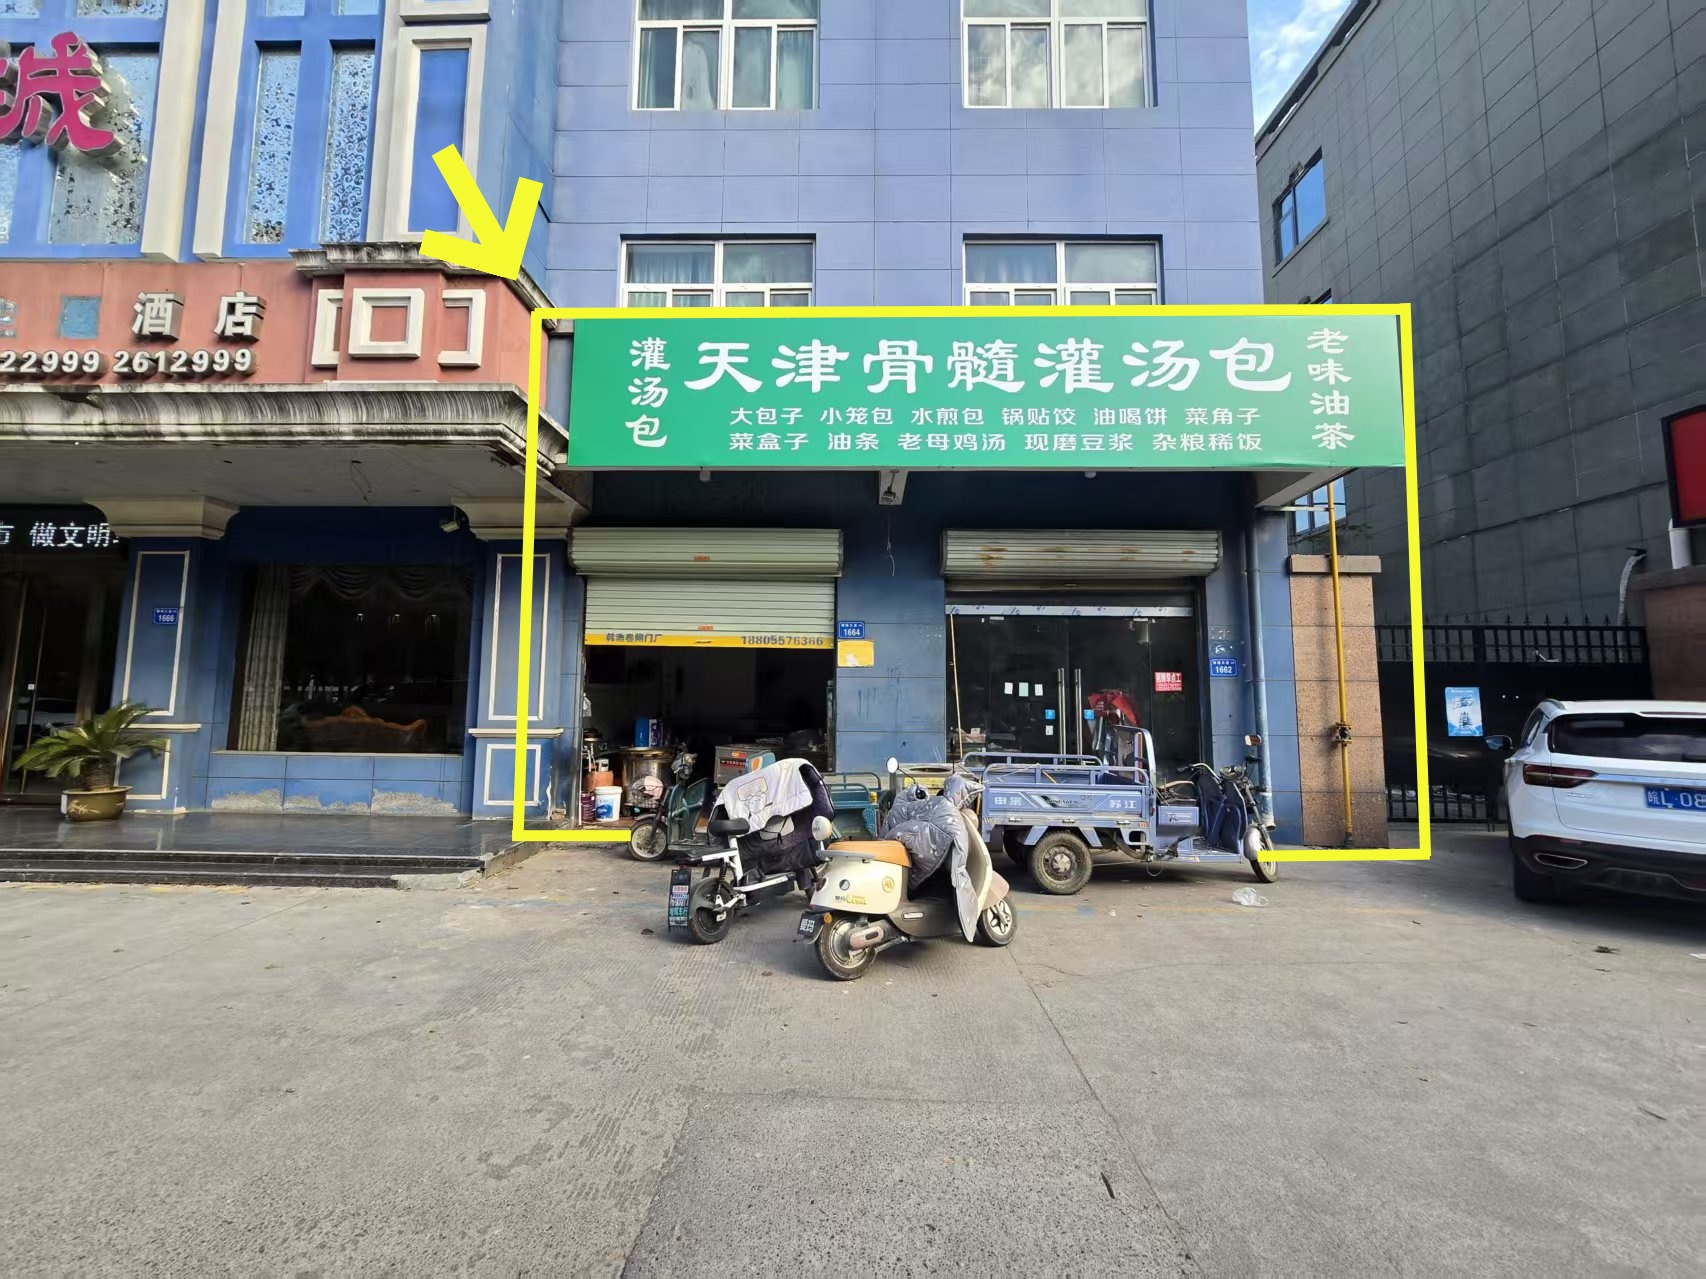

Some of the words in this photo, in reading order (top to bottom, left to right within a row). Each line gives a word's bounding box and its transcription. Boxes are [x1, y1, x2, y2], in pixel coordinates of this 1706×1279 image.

[132, 290, 260, 337] 酒店
[112, 348, 253, 373] 2612999
[683, 337, 1291, 394] 天津骨髓灌汤包
[625, 336, 671, 448] 灌汤包
[1305, 328, 1356, 450] 老味油茶
[731, 406, 803, 425] 大包子
[820, 406, 893, 425] 小笼包
[911, 406, 984, 426] 水煎包
[1001, 406, 1078, 426] 锅贴饺
[1093, 406, 1168, 426] 油喝饼
[1184, 406, 1263, 426] 菜角子
[729, 432, 809, 451] 菜盒子
[828, 432, 880, 452] 油条
[898, 432, 1006, 452] 老母鸡汤
[1024, 432, 1134, 452] 现磨豆浆
[1151, 432, 1264, 452] 杂粮稀饭
[29, 520, 119, 547] 做文明
[843, 628, 862, 636] 1664
[1215, 665, 1233, 674] 1662
